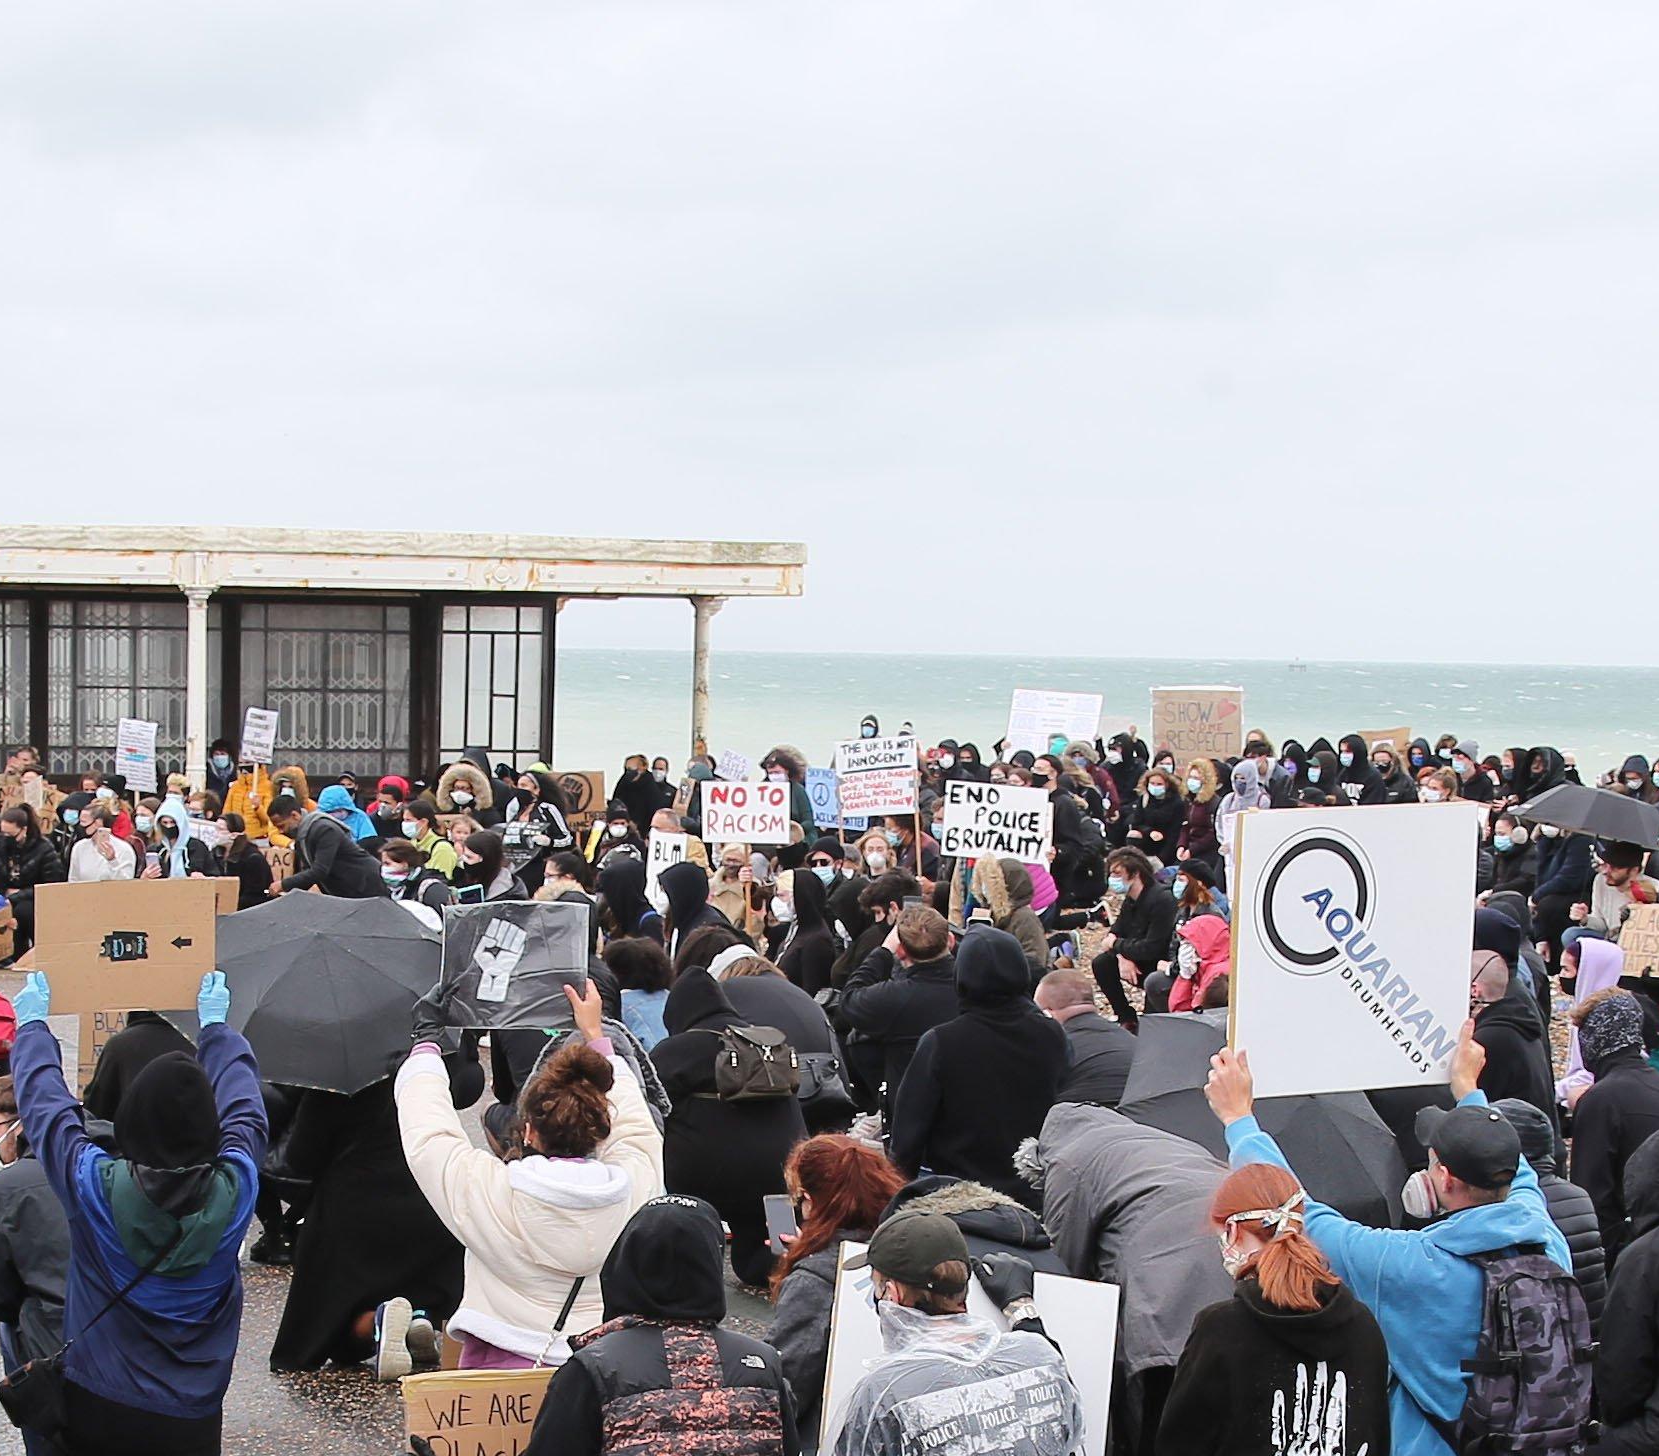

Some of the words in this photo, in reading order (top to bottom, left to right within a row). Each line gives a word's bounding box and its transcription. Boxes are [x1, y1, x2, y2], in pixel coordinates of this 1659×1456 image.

[1163, 701, 1213, 724] SHOW
[841, 743, 861, 755] THE
[865, 741, 880, 752] UK
[883, 740, 894, 750] IS
[896, 739, 915, 749] NOT
[1165, 730, 1233, 752] RESPECT
[848, 753, 905, 769] INNOCENT
[710, 785, 747, 807] NO
[757, 785, 785, 807] TO
[950, 784, 1000, 804] END
[707, 809, 785, 835] RACISM
[975, 806, 1040, 833] POLICE
[654, 840, 682, 864] BLM
[945, 827, 1044, 860] BRUTALITY
[1301, 888, 1457, 1062] AQUARIAN
[1340, 967, 1433, 1075] DRUMHEADS
[424, 1394, 473, 1431] WE
[488, 1393, 533, 1427] ARE
[981, 1406, 1019, 1430] POLICE
[921, 1421, 962, 1449] POLICE
